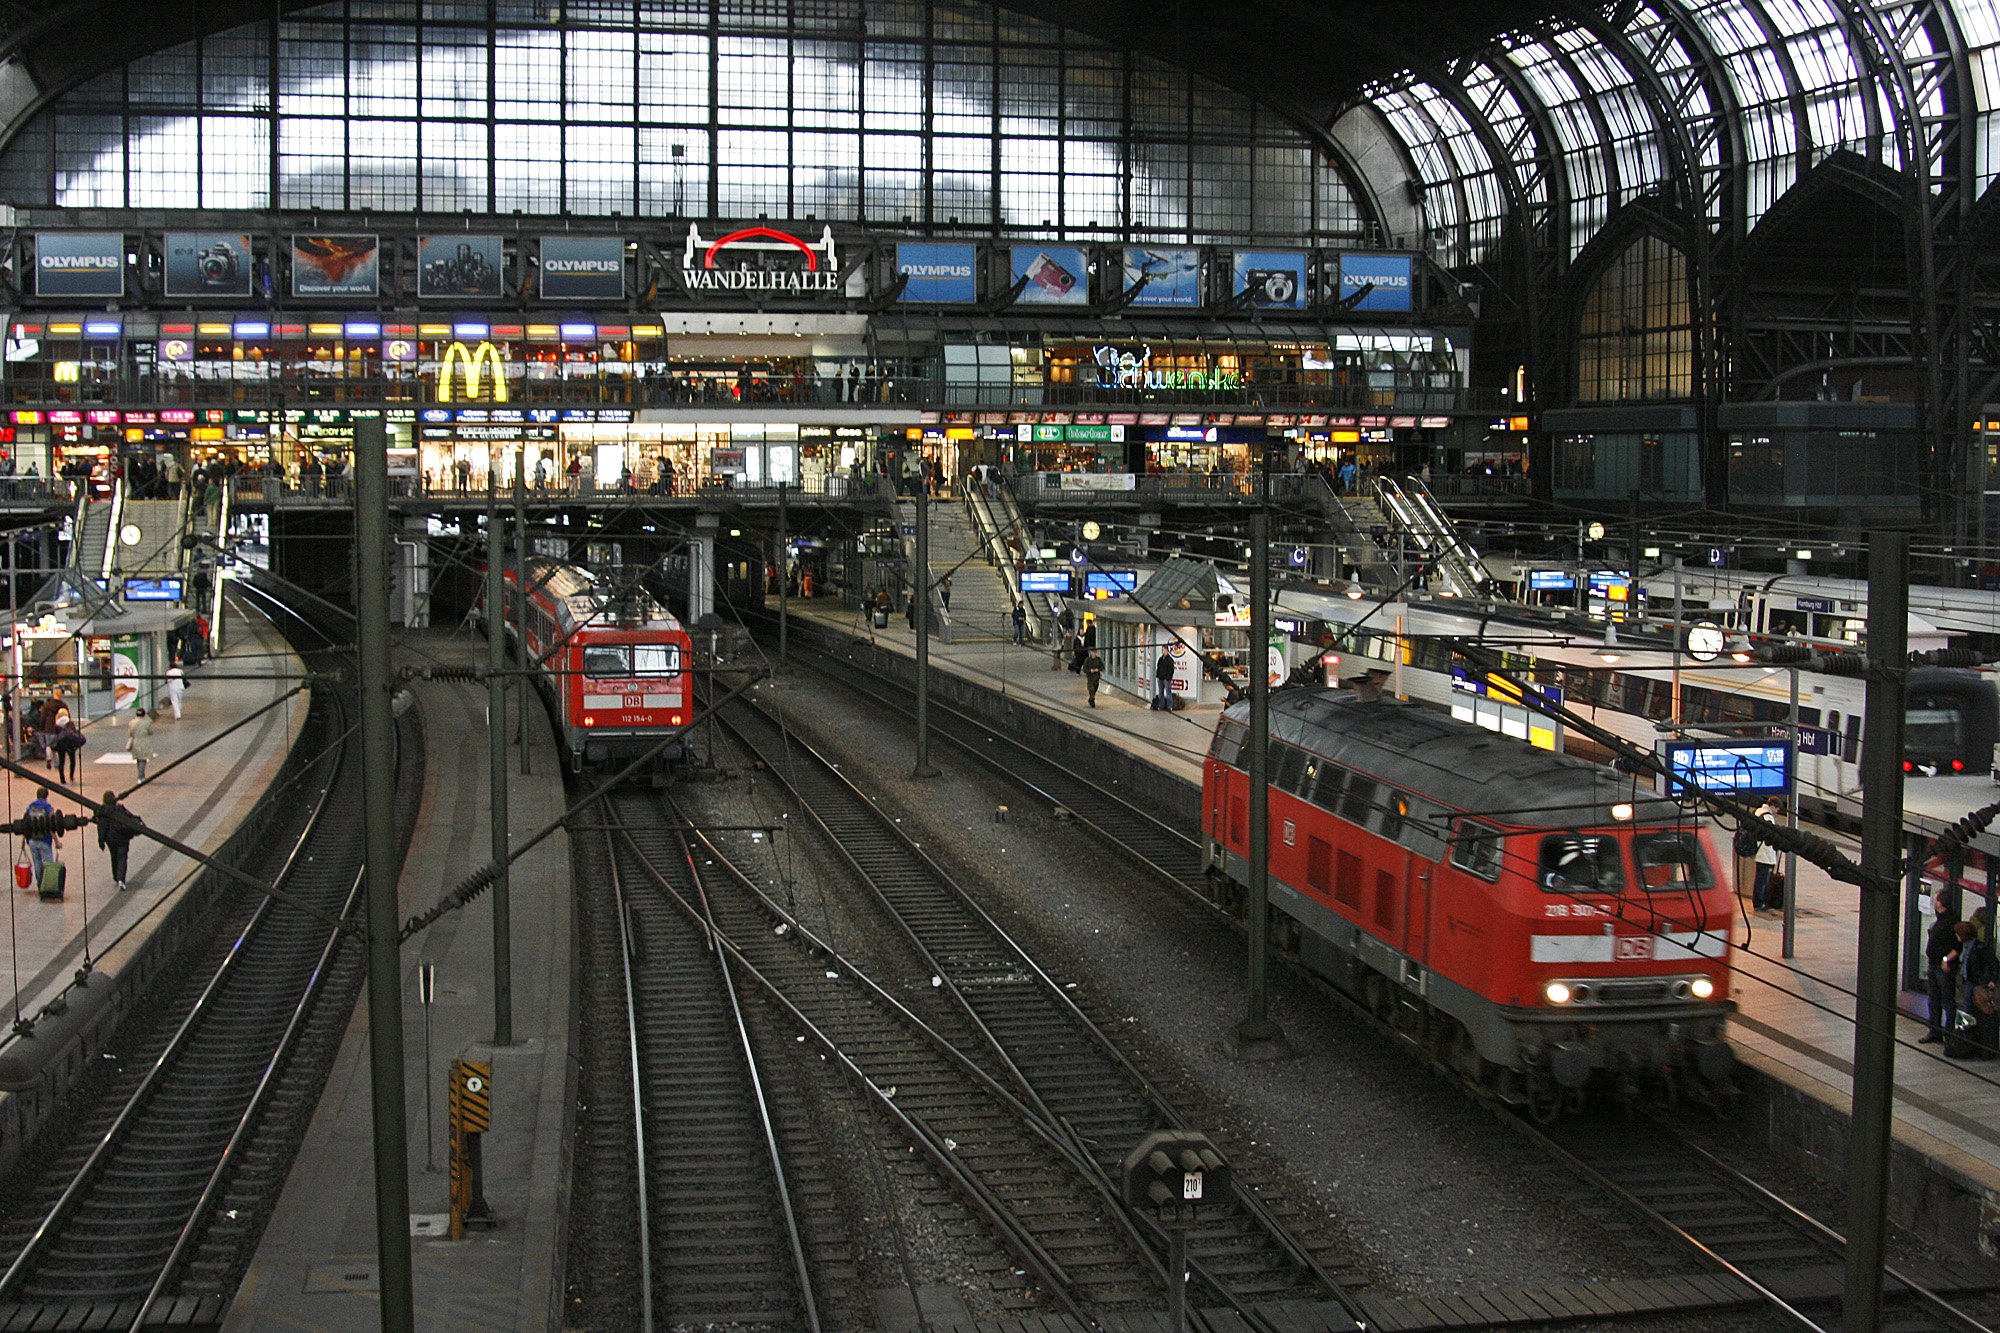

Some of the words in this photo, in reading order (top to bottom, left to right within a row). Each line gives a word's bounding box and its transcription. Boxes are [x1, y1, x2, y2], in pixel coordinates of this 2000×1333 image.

[41, 254, 119, 268] OLYMPUS
[545, 259, 619, 272] OLYMPUS
[901, 264, 971, 277] OLYMPUS
[683, 270, 838, 289] WANDELHALLE
[1343, 274, 1407, 288] OLYMPUS
[340, 428, 354, 436] SHO
[1710, 549, 1720, 562] D
[625, 696, 641, 707] DB
[1802, 731, 1815, 746] Hbf
[1618, 937, 1650, 959] DB
